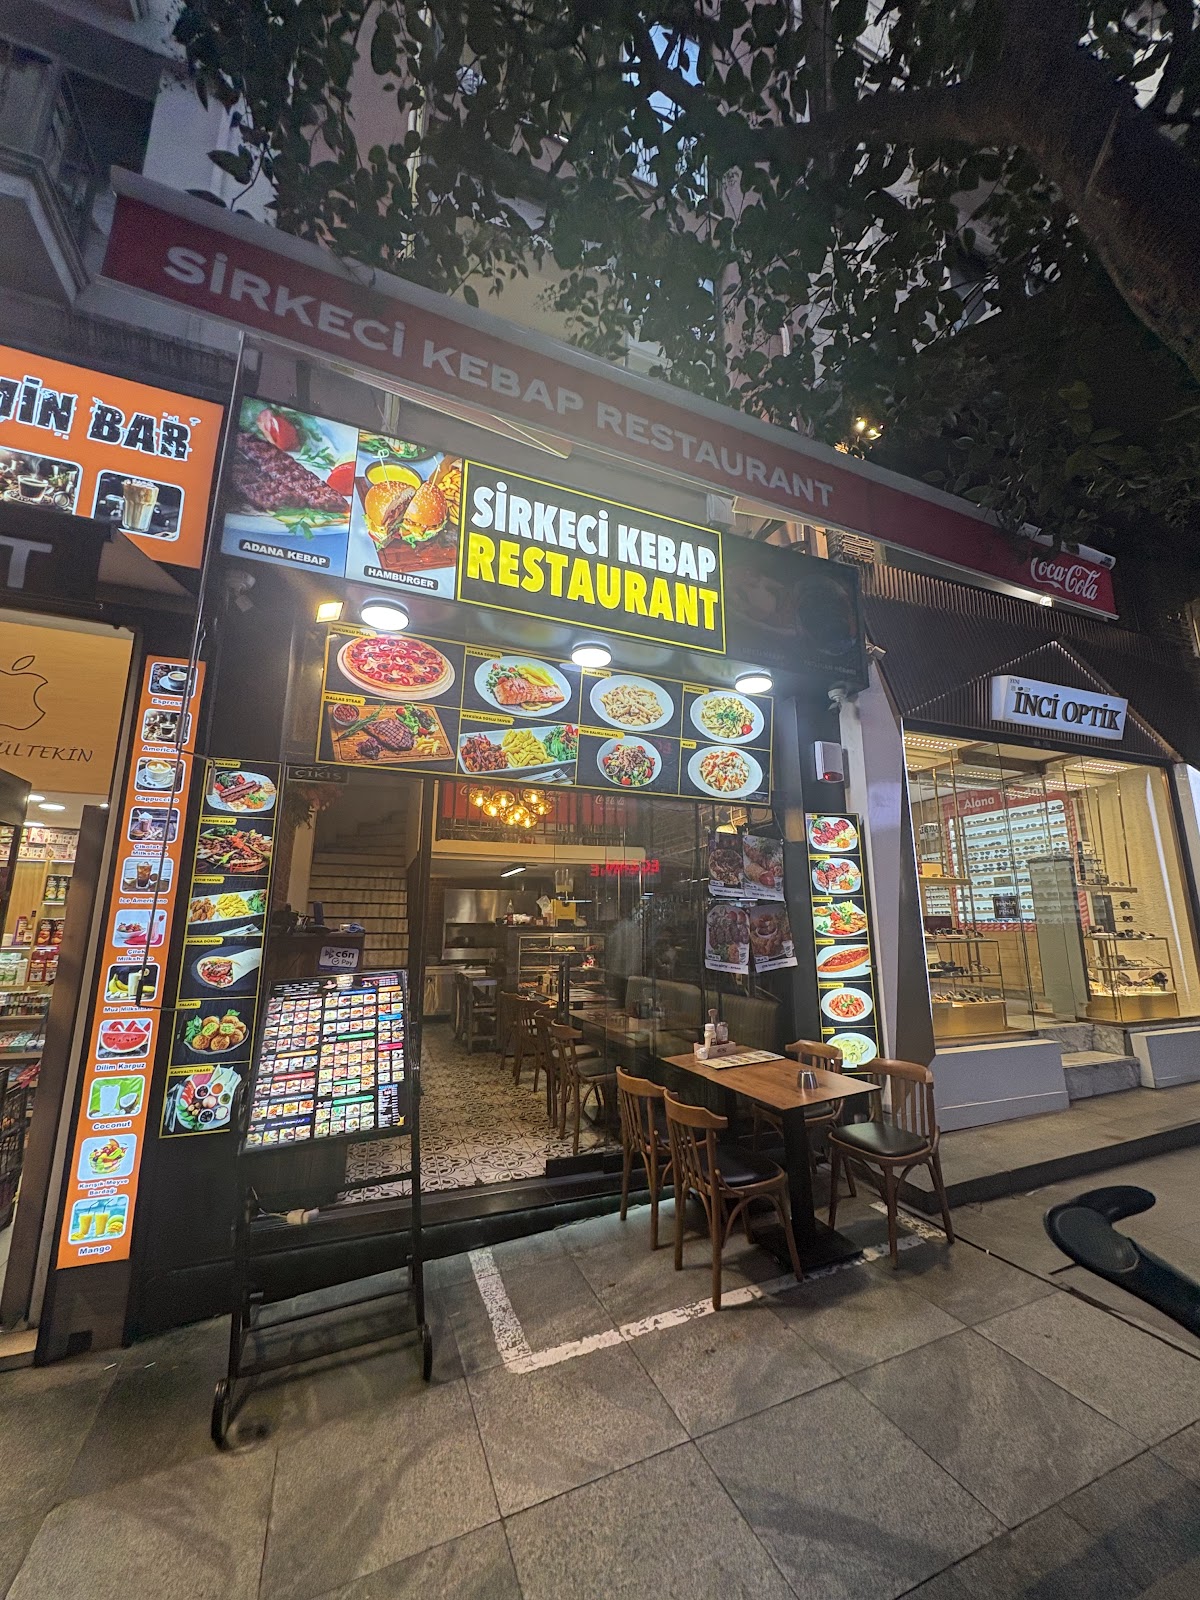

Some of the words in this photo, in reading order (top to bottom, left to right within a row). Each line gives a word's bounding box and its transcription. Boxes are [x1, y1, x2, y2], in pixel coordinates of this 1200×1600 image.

[162, 246, 406, 358] SİRKECİ
[423, 340, 584, 415] KEBAP
[596, 401, 834, 507] RESTAURANT
[88, 400, 191, 461] BAR
[471, 481, 609, 558] SİRKECİ
[617, 524, 717, 583] KEBAP
[243, 541, 285, 558] ADANA
[287, 549, 327, 567] KEBAP
[367, 568, 435, 589] HAMBURGER
[466, 532, 719, 631] RESTAURANT
[1031, 557, 1101, 600] Coca-Cola
[152, 698, 184, 706] Espress
[1012, 687, 1060, 720] İNCİ
[1062, 703, 1122, 731] OPTİK
[963, 796, 995, 810] Alana
[341, 959, 354, 967] Pay
[118, 1062, 145, 1071] Karpuz
[93, 1121, 131, 1130] Coconut
[106, 1179, 128, 1187] Meyve
[79, 1245, 111, 1255] Mango
